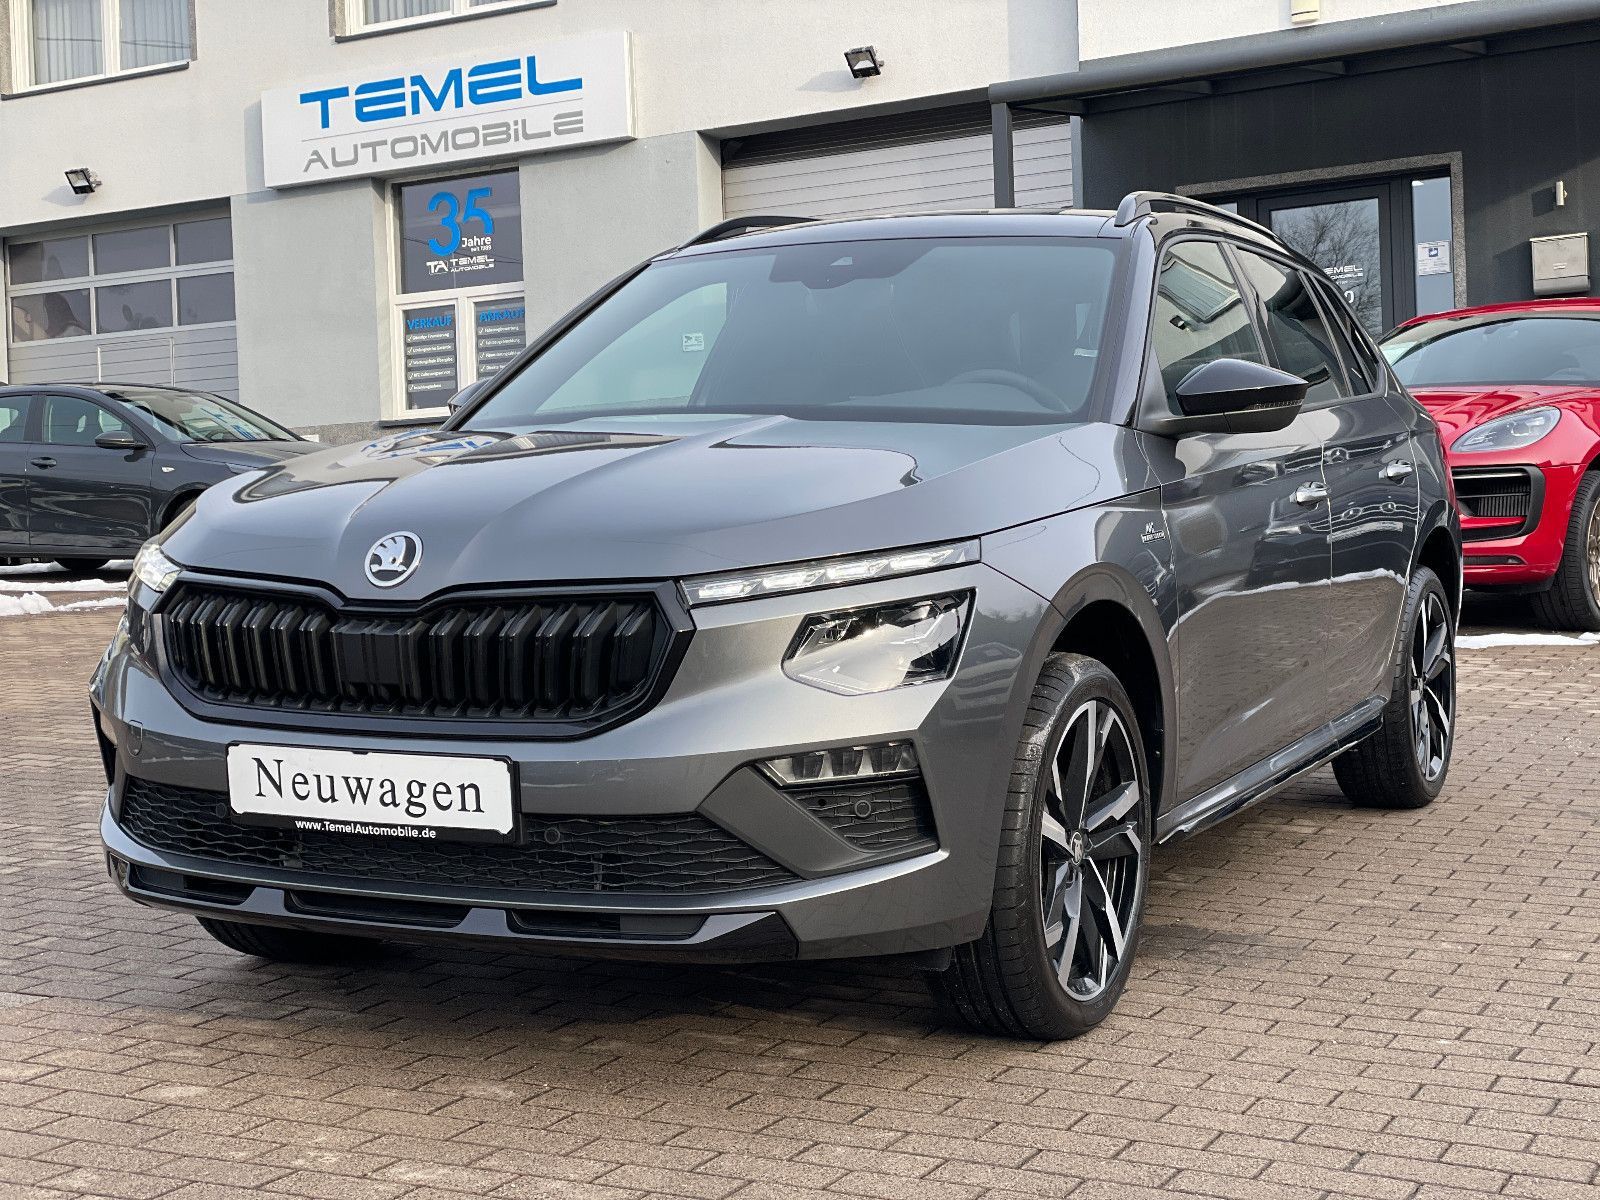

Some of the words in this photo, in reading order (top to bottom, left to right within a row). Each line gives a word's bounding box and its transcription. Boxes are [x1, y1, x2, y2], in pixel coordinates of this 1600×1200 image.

[300, 55, 583, 129] TEMEL
[427, 187, 494, 256] 35
[461, 236, 492, 248] Jahre
[450, 255, 495, 266] TEMEL
[1323, 265, 1363, 275] EMEL
[406, 315, 452, 330] VERKAUF
[252, 757, 485, 818] Neuwagen
[295, 820, 437, 839] www.TemelAutomobile.de
